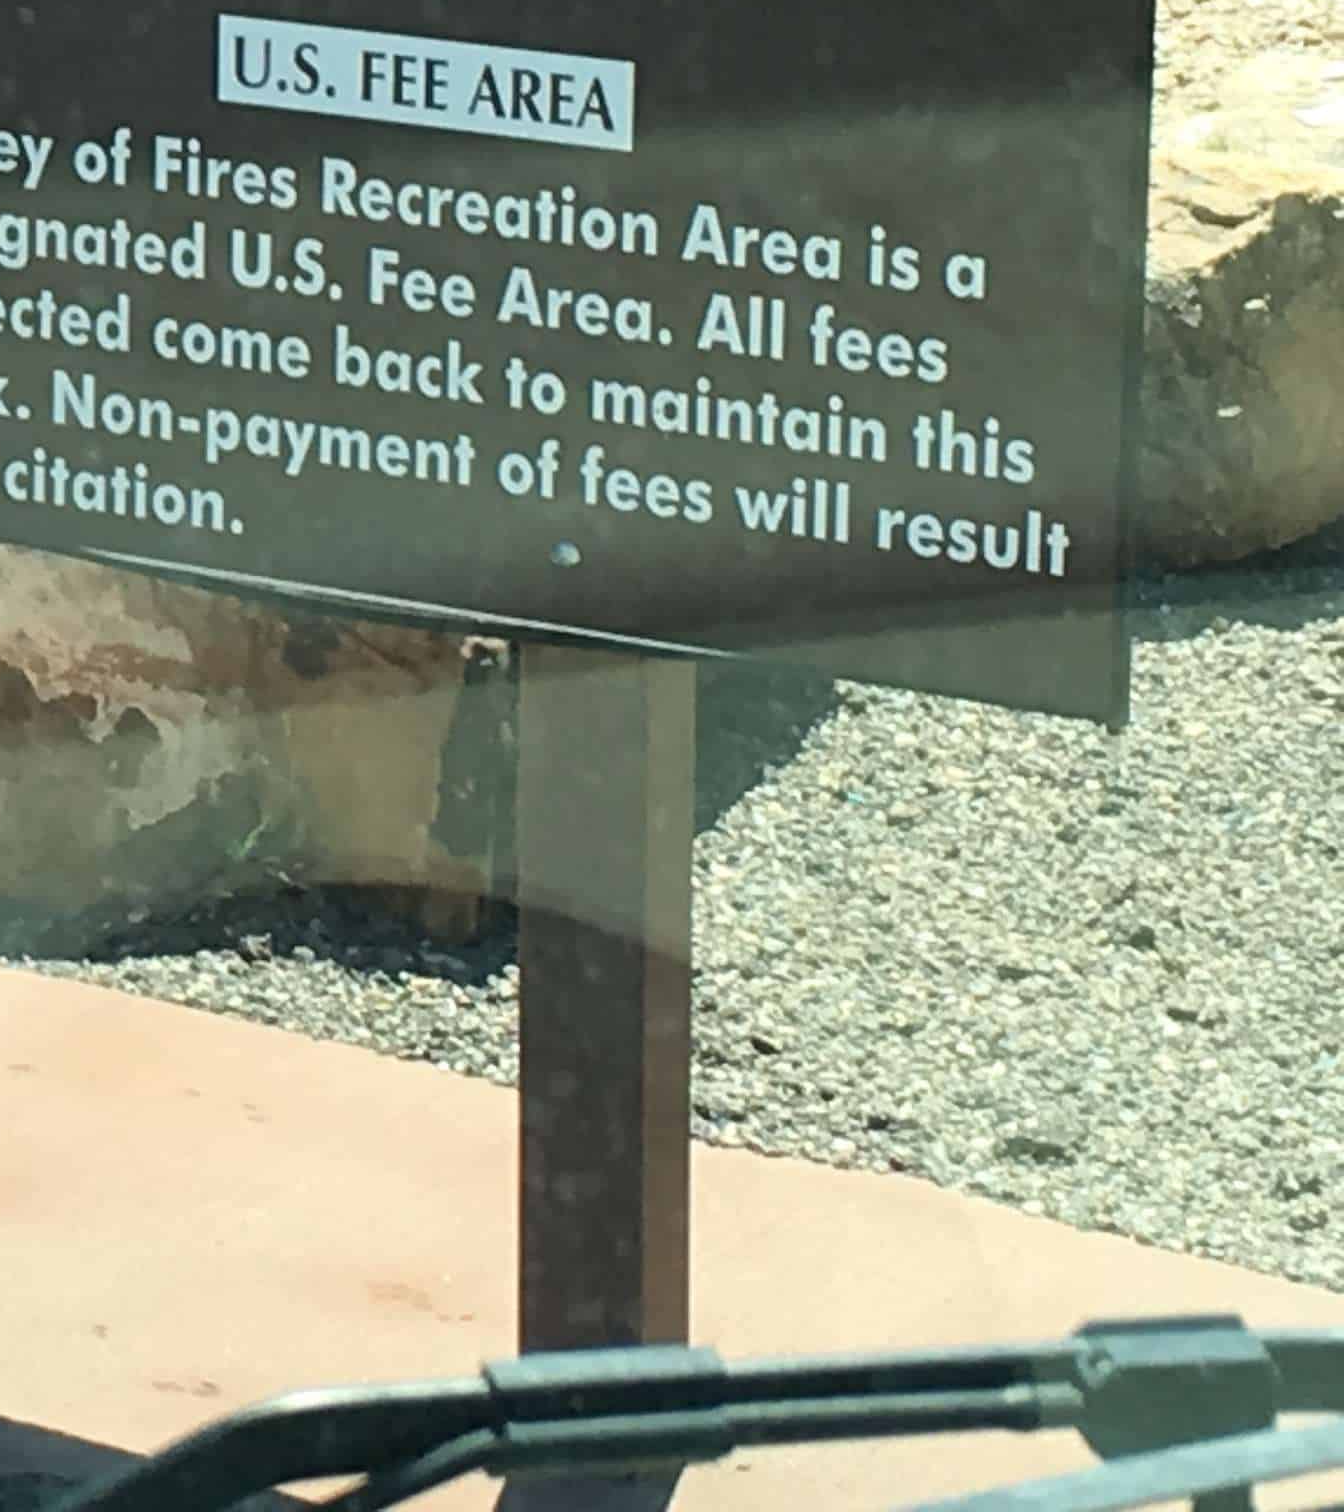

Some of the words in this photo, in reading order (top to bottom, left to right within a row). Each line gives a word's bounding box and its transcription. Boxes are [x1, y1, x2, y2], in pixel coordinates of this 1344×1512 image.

[234, 35, 336, 98] U.S.
[360, 50, 449, 110] FEE
[467, 63, 616, 133] AREA
[73, 127, 132, 187] of
[154, 135, 298, 210] Fires
[321, 156, 659, 257] Recreation
[681, 204, 842, 281] Area
[869, 225, 920, 292] is
[945, 254, 986, 299] a
[231, 228, 343, 301] U.S.
[369, 247, 476, 318] Fee
[497, 266, 673, 346] Area.
[697, 293, 786, 361] All
[809, 303, 948, 383] fees
[51, 369, 475, 486] Non-payment
[498, 439, 560, 499] of
[579, 445, 713, 523] fees
[735, 477, 851, 544] will
[877, 508, 1071, 577] result
[153, 317, 311, 379] come
[335, 324, 484, 404] back
[504, 357, 567, 415] to
[591, 376, 887, 463] maintain
[912, 409, 1035, 484] this
[4, 447, 244, 535] citation.
